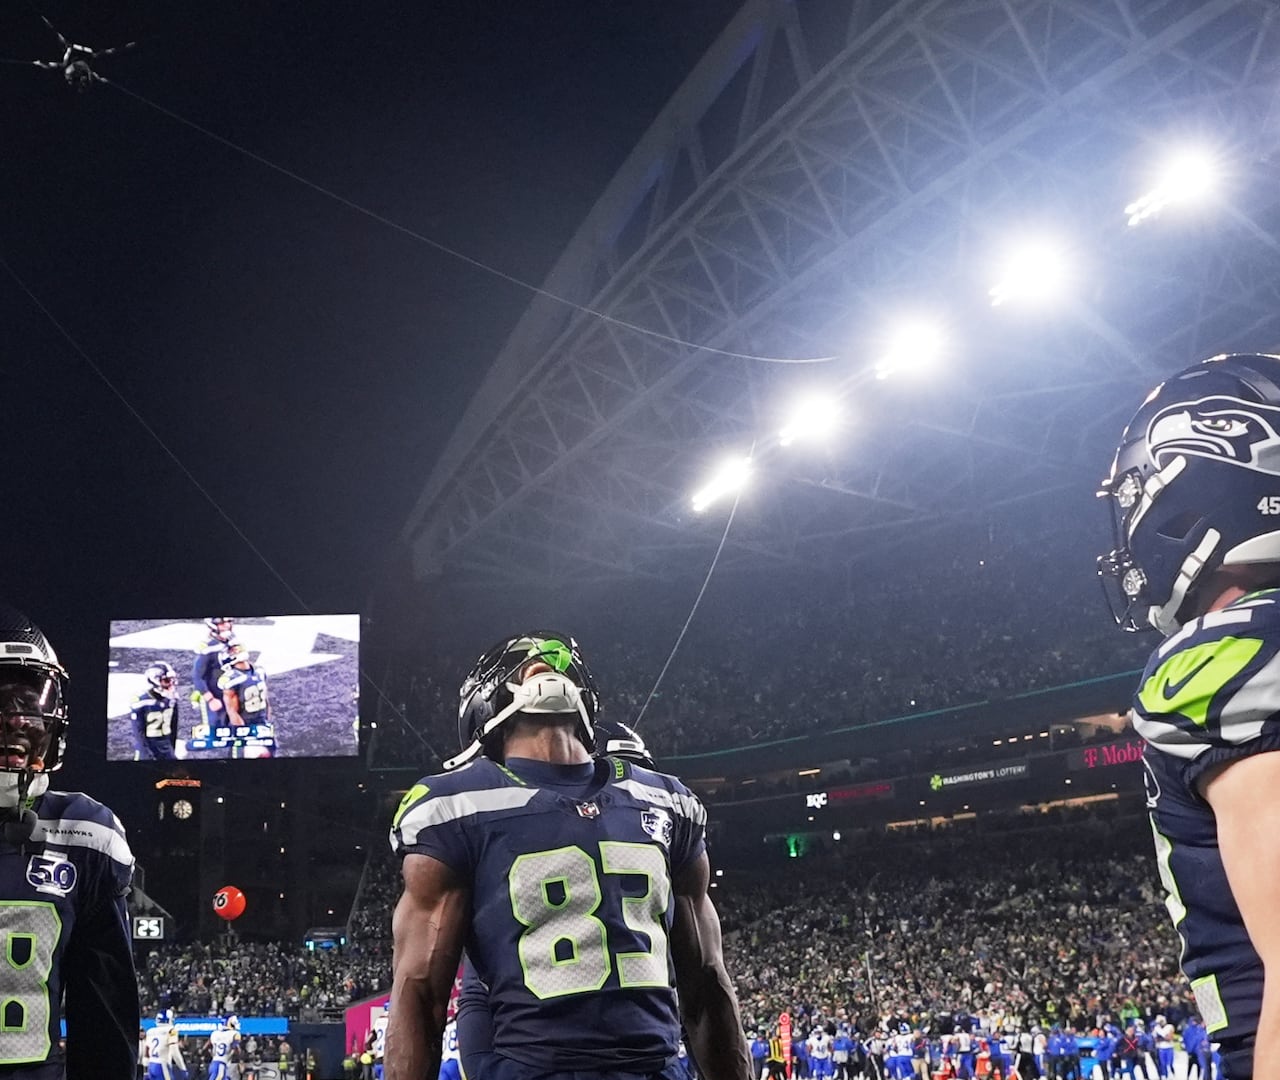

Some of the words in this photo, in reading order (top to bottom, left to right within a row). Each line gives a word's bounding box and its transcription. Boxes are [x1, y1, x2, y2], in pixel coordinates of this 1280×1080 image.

[1257, 496, 1280, 515] 45
[1102, 741, 1146, 767] Mobi
[995, 765, 1028, 779] LOTTERY
[41, 827, 93, 838] SEAHAWKS
[27, 855, 77, 893] 50
[138, 920, 160, 937] 25
[508, 840, 672, 1000] 83
[151, 1037, 160, 1057] 2
